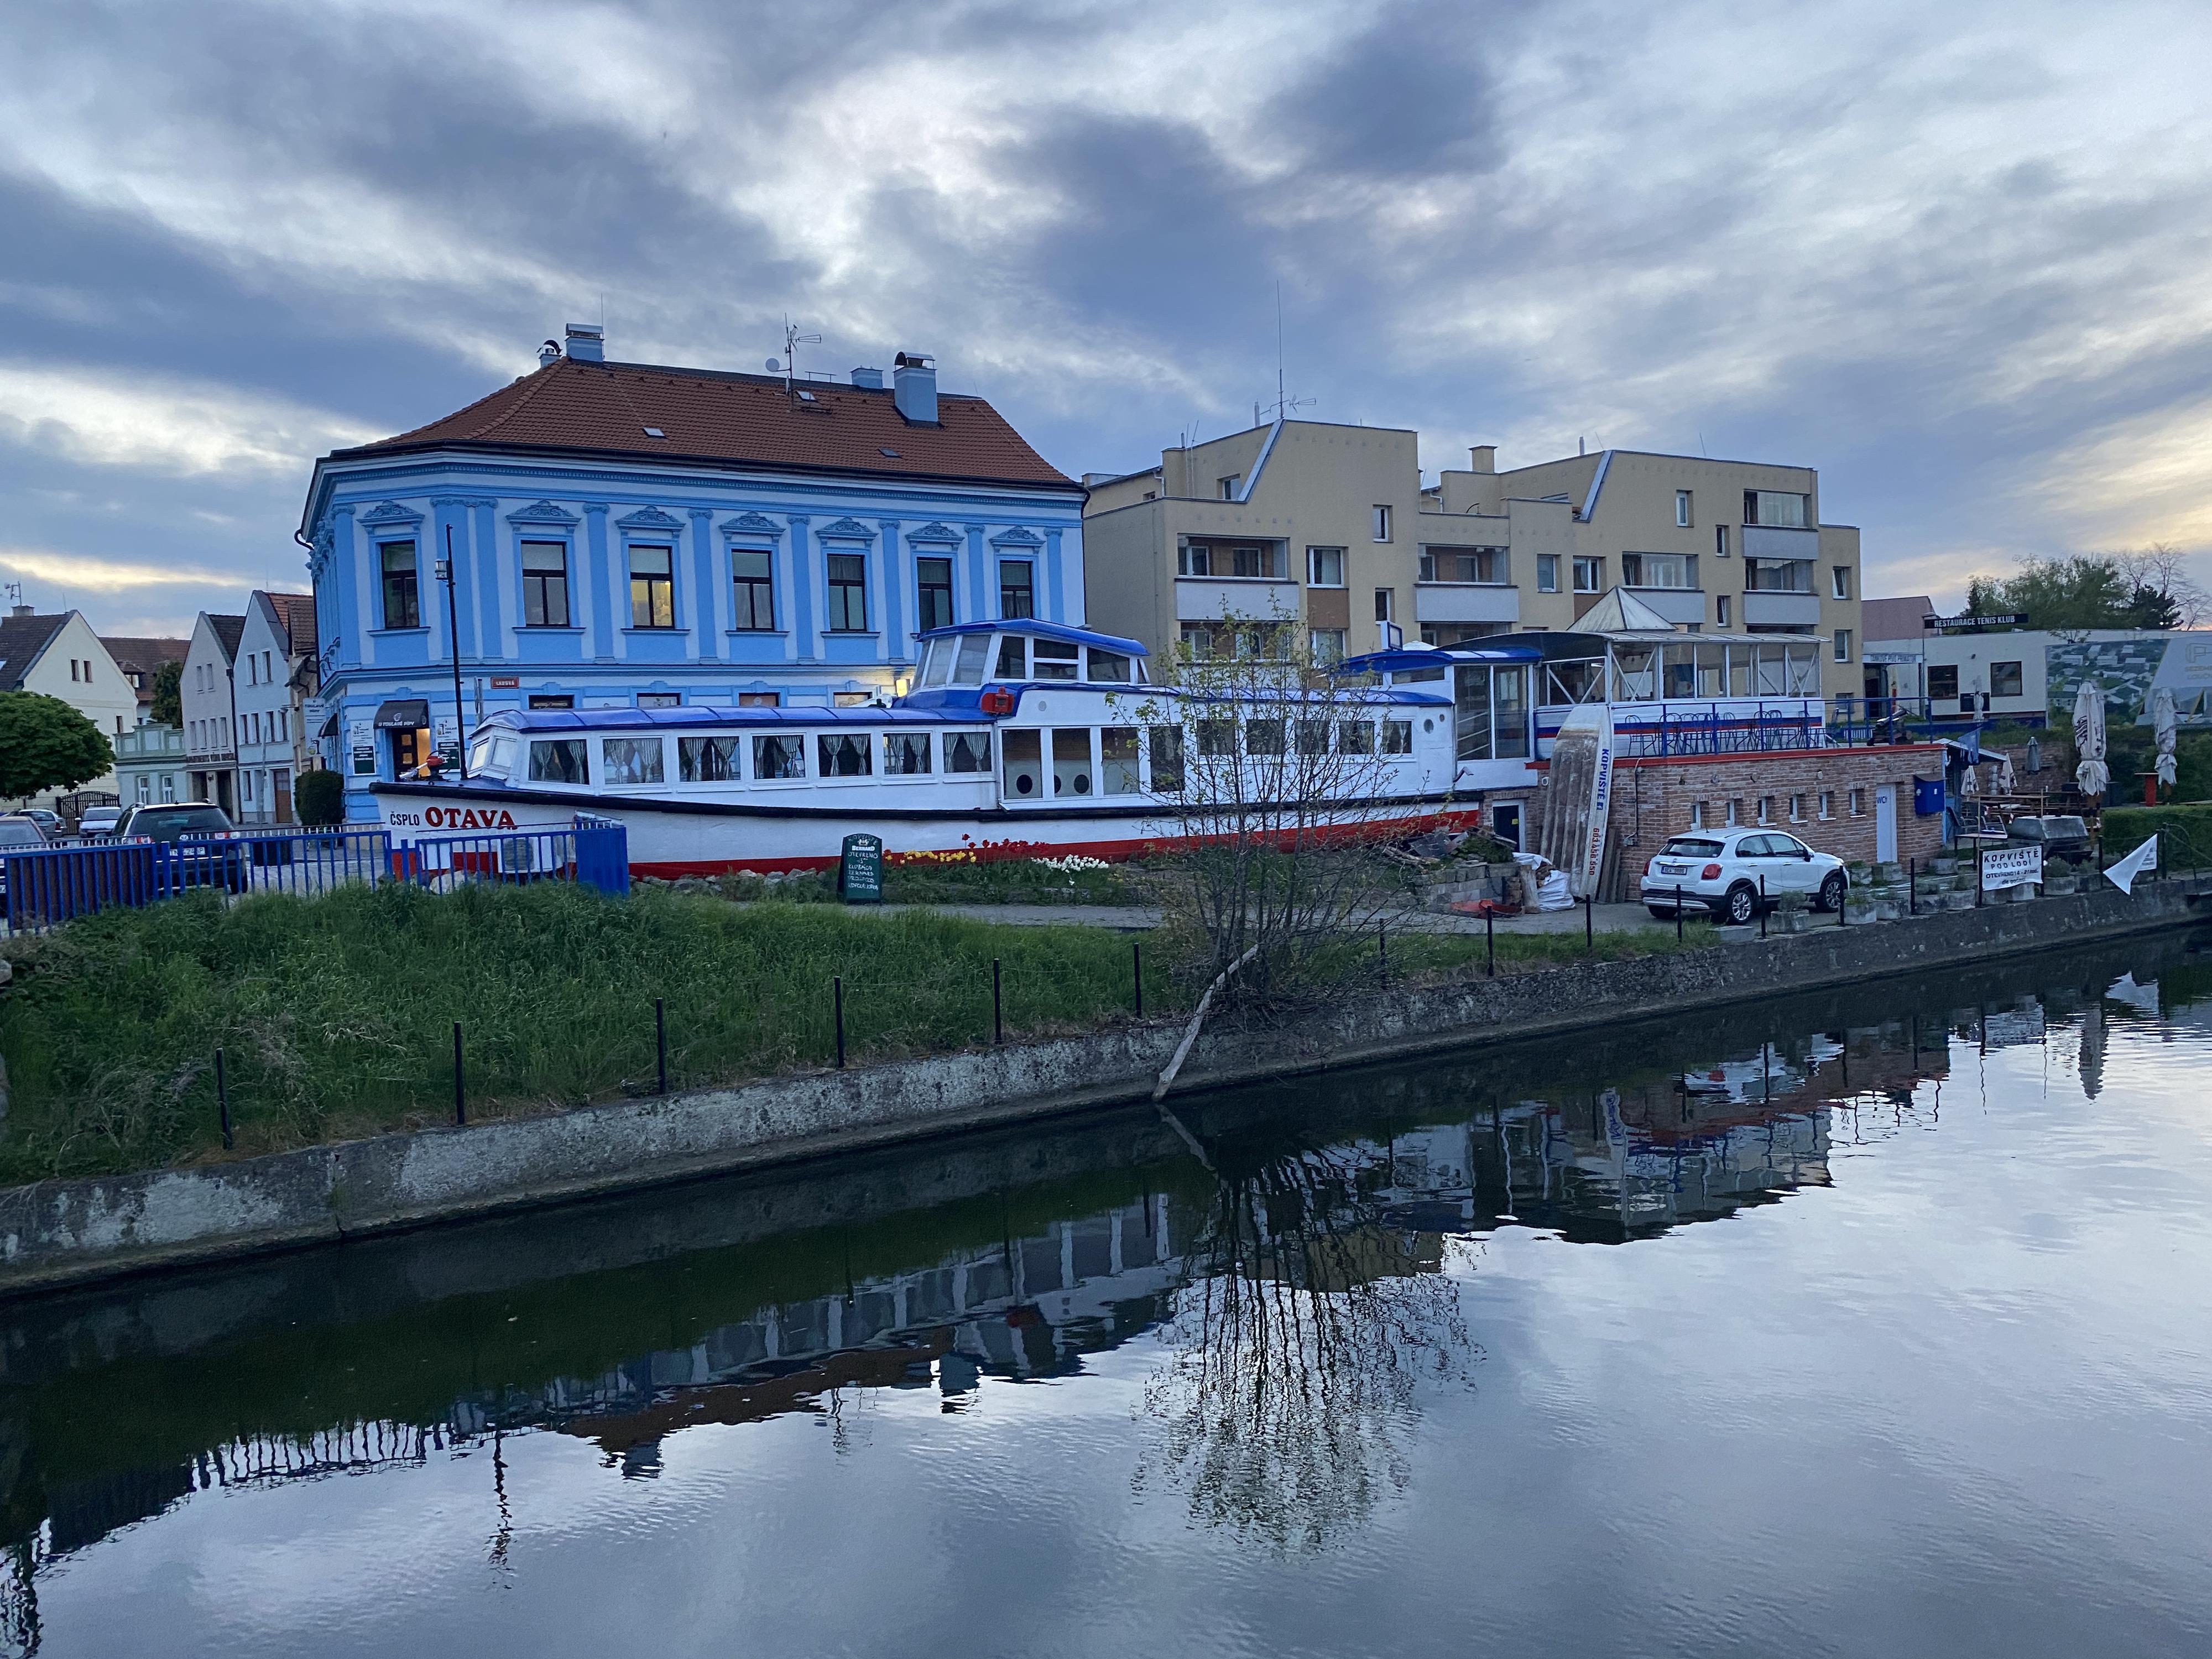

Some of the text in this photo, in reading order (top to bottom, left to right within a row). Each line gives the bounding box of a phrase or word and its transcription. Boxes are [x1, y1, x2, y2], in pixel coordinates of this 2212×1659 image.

[1934, 618, 1975, 627] RESTAURACE
[1977, 617, 1996, 625] TENIS
[1597, 749, 1609, 800] KOPVIŠTĚ
[390, 807, 518, 830] ČSPLO OTAVA
[1984, 849, 2039, 863] KOPVIŠTĚ
[2011, 859, 2031, 867] LODÍ
